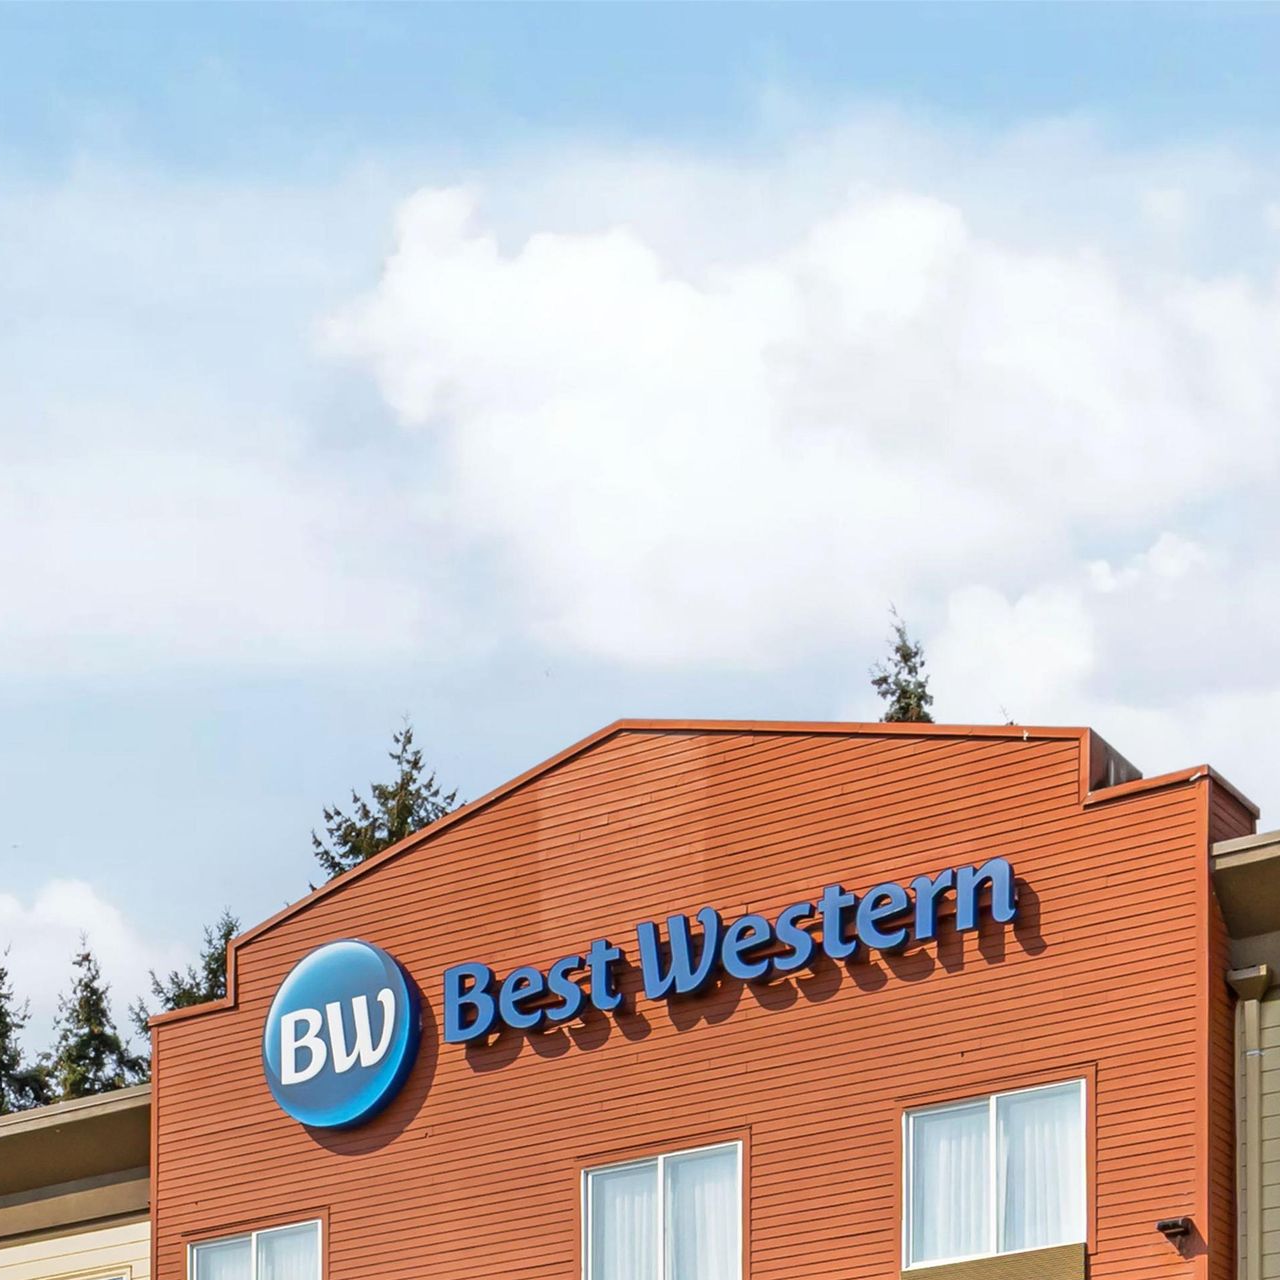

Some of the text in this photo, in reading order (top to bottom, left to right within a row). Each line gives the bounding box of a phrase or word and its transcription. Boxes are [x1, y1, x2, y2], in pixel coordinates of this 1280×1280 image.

[443, 856, 1017, 1044] Best Western
[280, 987, 396, 1085] BW
